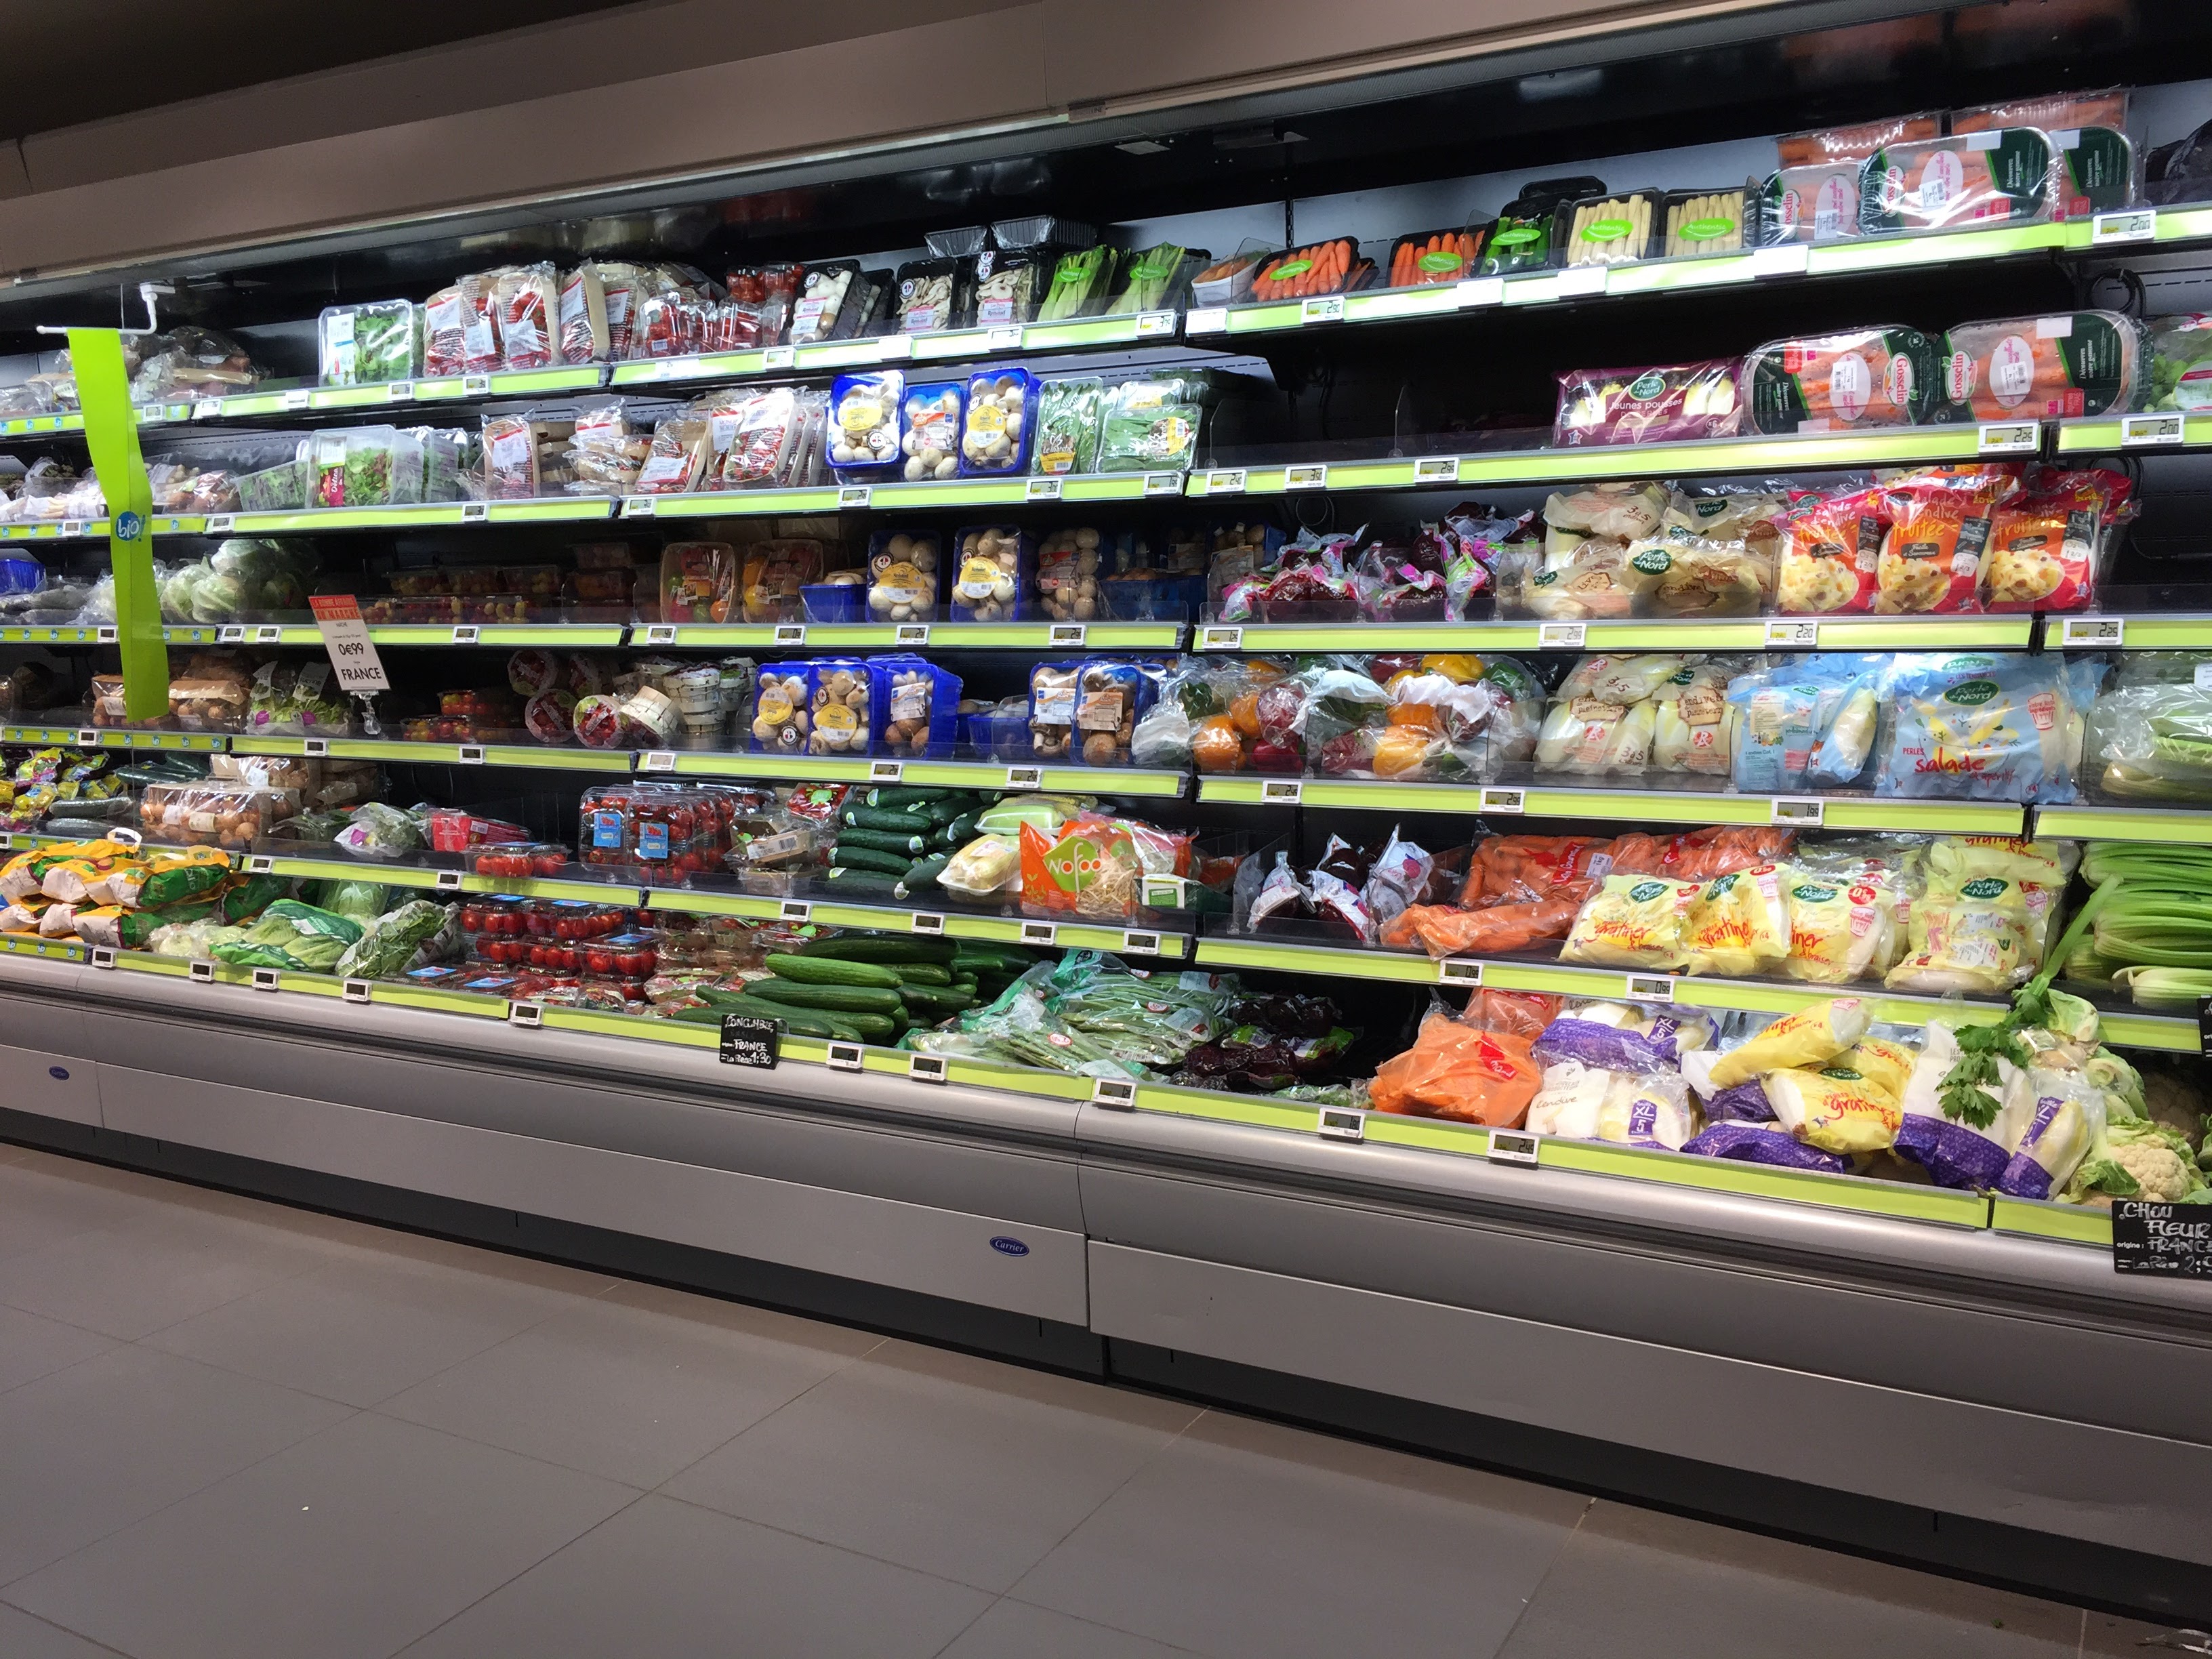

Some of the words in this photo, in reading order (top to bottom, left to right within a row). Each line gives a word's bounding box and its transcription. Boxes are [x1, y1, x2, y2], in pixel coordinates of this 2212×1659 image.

[1896, 357, 1908, 404] Gosselin
[1952, 352, 1964, 400] Gosselin
[1637, 380, 1658, 390] Perle
[1639, 386, 1660, 396] Nord
[1696, 503, 1723, 513] Nord
[1892, 518, 1945, 546] fruitée
[1639, 560, 1668, 571] Nord
[338, 642, 364, 655] 0€99
[341, 668, 382, 680] FRANCE
[1956, 684, 1990, 694] Perle
[1958, 690, 1992, 701] Nord
[1902, 747, 1925, 756] PERLES
[1914, 746, 1986, 774] salade
[1969, 880, 1997, 889] Perle
[1971, 886, 2003, 896] Nord
[733, 1039, 768, 1052] FRANCE
[1633, 1107, 1654, 1117] XL
[1637, 1120, 1646, 1133] 5
[2144, 1220, 2211, 1239] FLEUR
[996, 1240, 1025, 1252] Carrier
[2147, 1237, 2212, 1255] FRANCE
